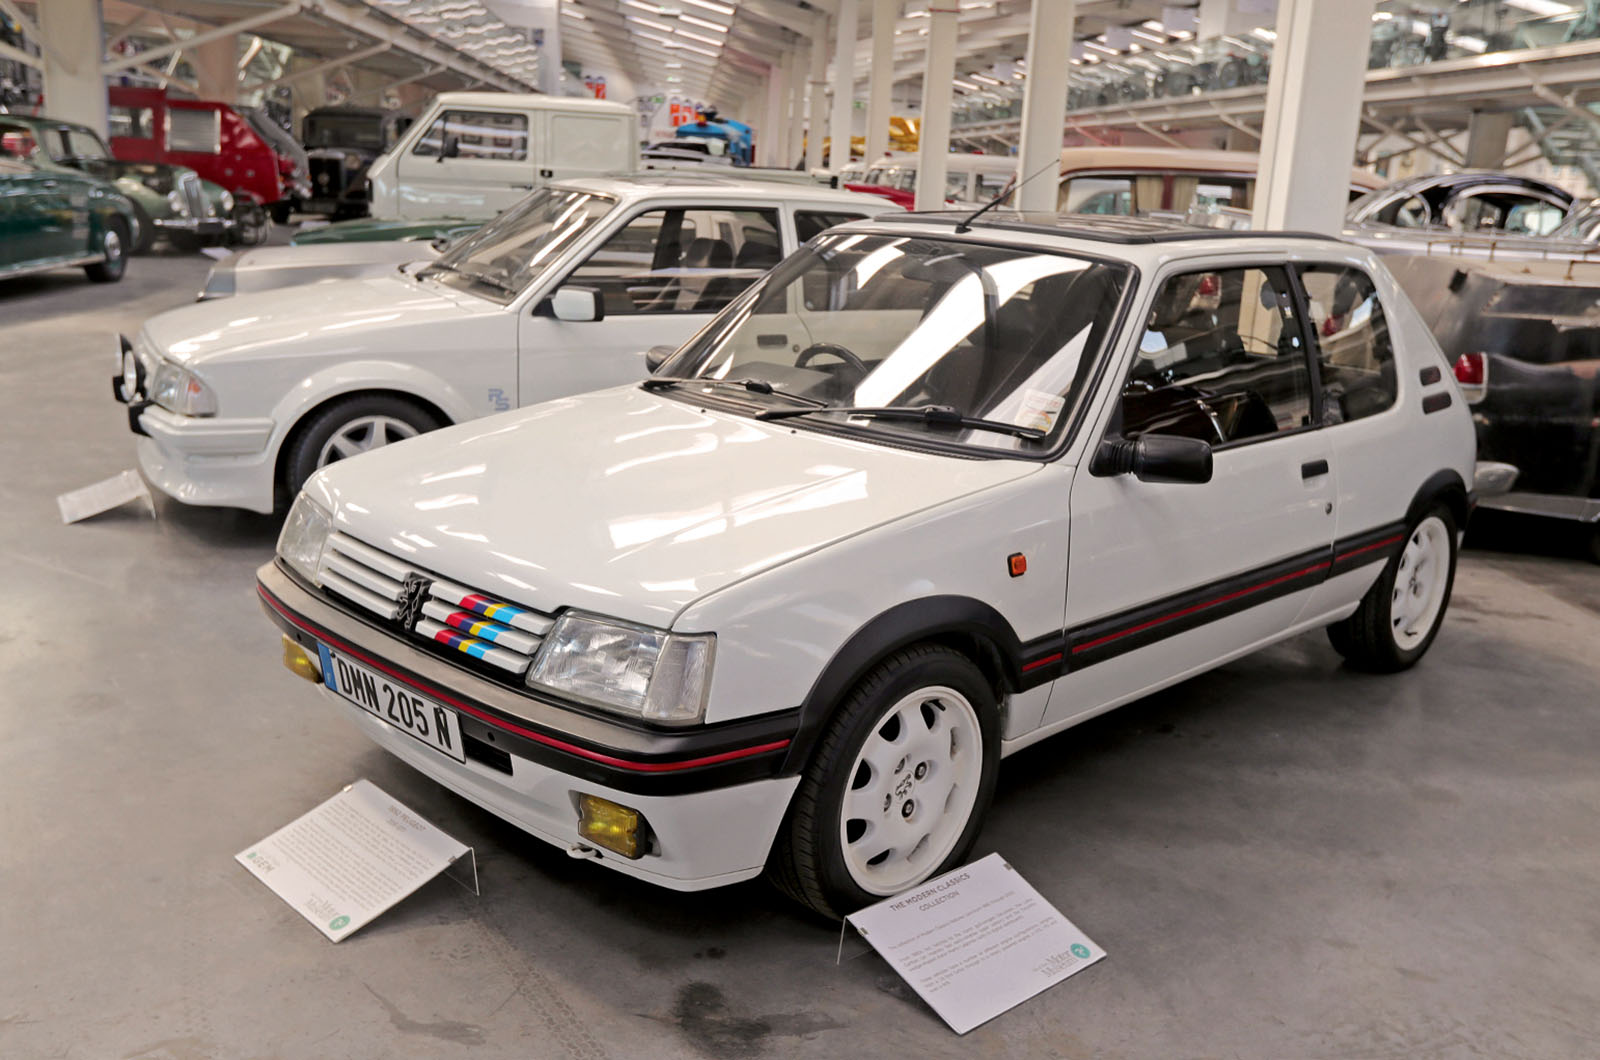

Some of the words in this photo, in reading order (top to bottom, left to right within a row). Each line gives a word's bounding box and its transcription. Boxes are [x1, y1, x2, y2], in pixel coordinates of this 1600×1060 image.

[337, 657, 380, 712] DMN
[383, 683, 429, 737] 205
[433, 705, 452, 751] N
[889, 901, 906, 912] THE
[905, 887, 937, 905] MODERN
[936, 872, 970, 892] CLASSICS
[919, 890, 961, 911] COLLECTION
